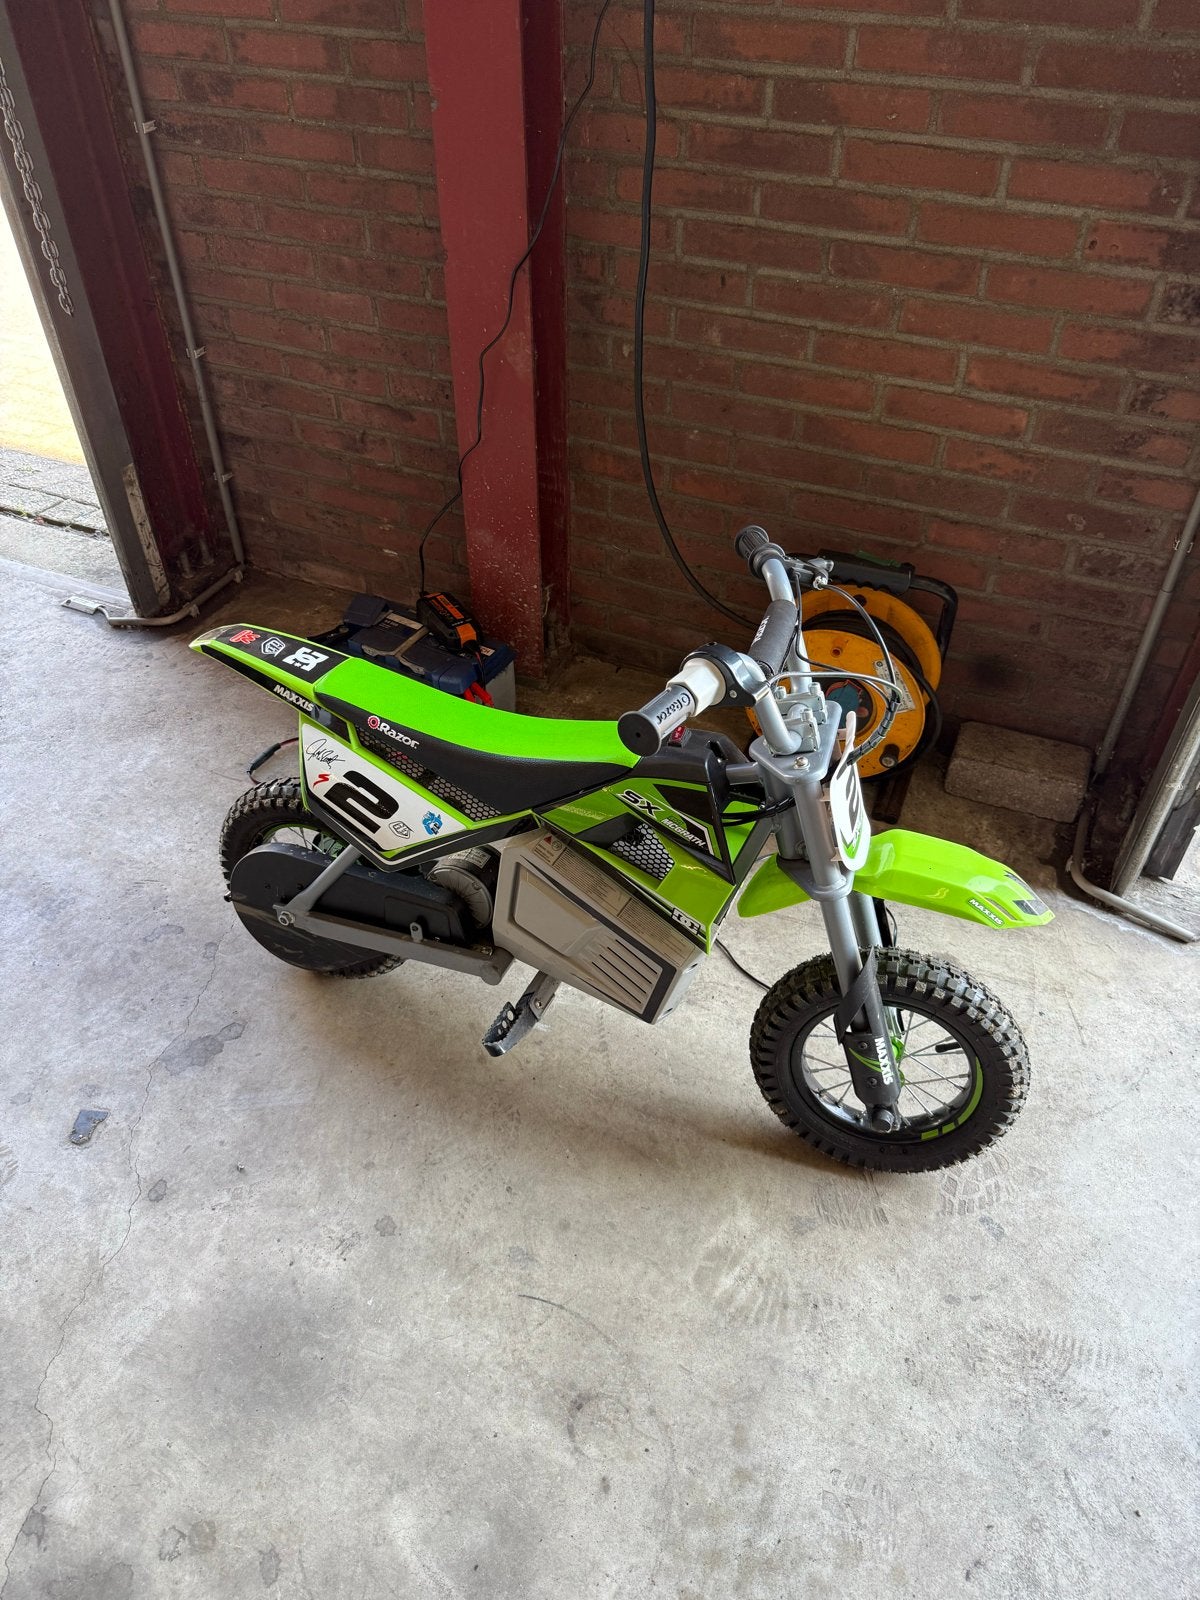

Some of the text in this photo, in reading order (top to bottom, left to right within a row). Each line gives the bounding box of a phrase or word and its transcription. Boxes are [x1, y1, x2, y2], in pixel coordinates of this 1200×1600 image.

[273, 684, 315, 712] MAXXIS
[380, 722, 420, 748] Razor
[324, 770, 399, 834] 2
[617, 789, 665, 819] SX
[660, 818, 707, 848] MCGRATH
[969, 899, 1003, 925] MAXXIS
[874, 1037, 894, 1085] MAXXIS
